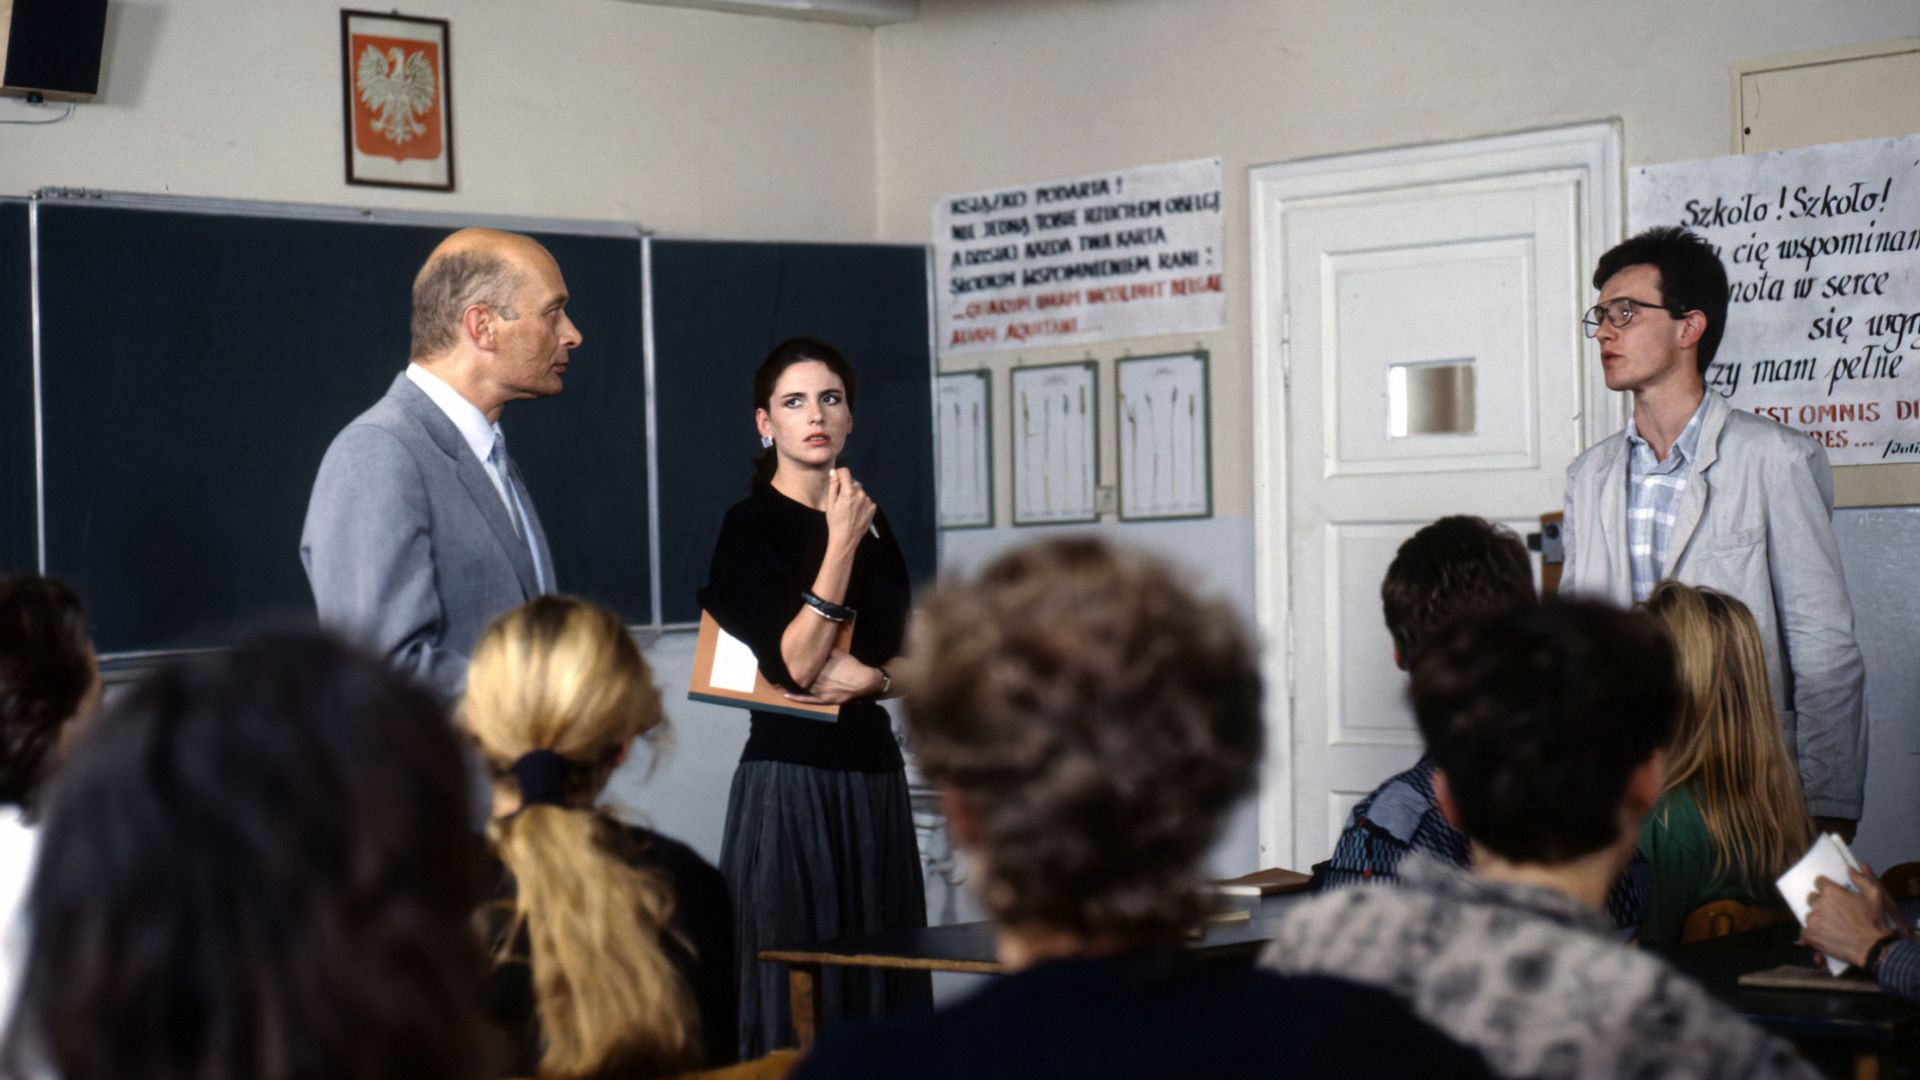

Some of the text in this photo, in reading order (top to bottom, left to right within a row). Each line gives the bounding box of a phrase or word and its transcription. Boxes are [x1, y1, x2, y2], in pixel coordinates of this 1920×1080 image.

[1732, 231, 1770, 270] cię
[1793, 276, 1819, 300] w
[1821, 270, 1890, 300] serce
[1807, 306, 1854, 345] się
[1751, 356, 1817, 385] mam
[1823, 344, 1904, 397] pełne
[1799, 401, 1881, 424] OMNIS
